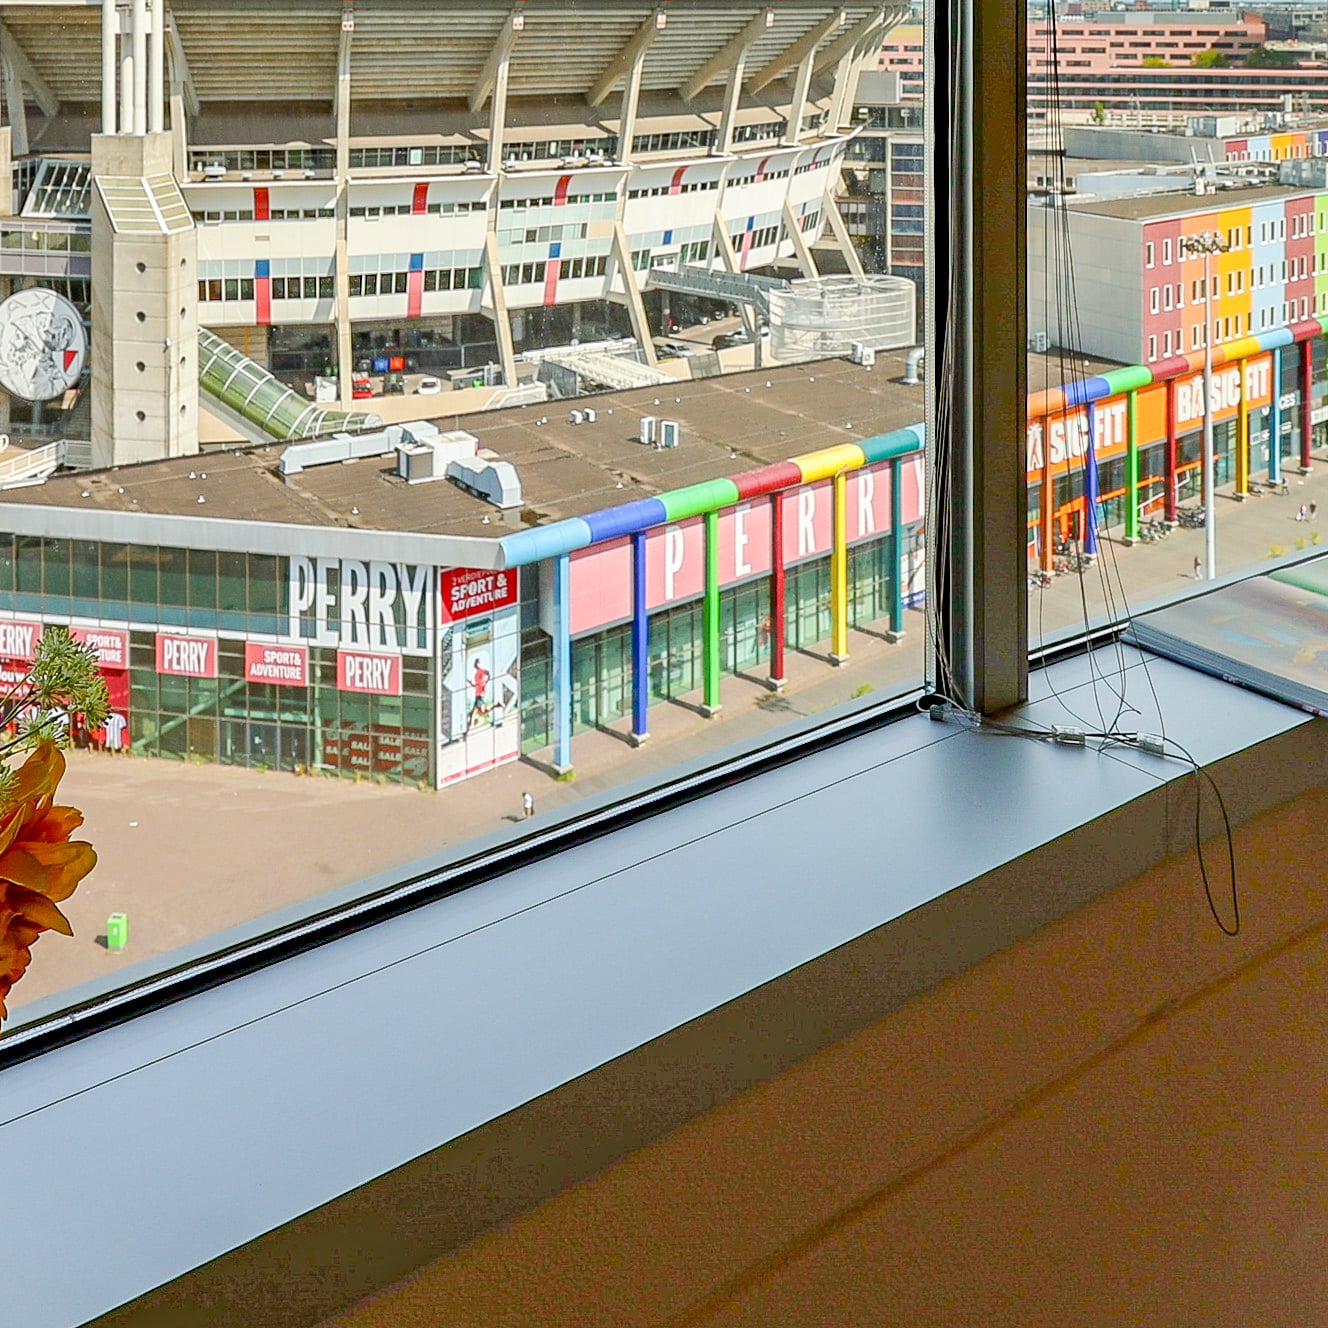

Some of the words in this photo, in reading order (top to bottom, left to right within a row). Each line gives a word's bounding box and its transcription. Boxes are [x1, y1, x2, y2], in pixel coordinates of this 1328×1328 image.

[1093, 403, 1127, 450] FIT
[451, 576, 494, 601] SPORT
[497, 573, 507, 587] &
[451, 587, 508, 614] ADVENTURE
[289, 554, 424, 653] PERRY
[163, 639, 208, 672] PERRY
[264, 650, 302, 666] SPORT&
[250, 663, 302, 680] ADVENTURE
[345, 655, 392, 690] PERRY
